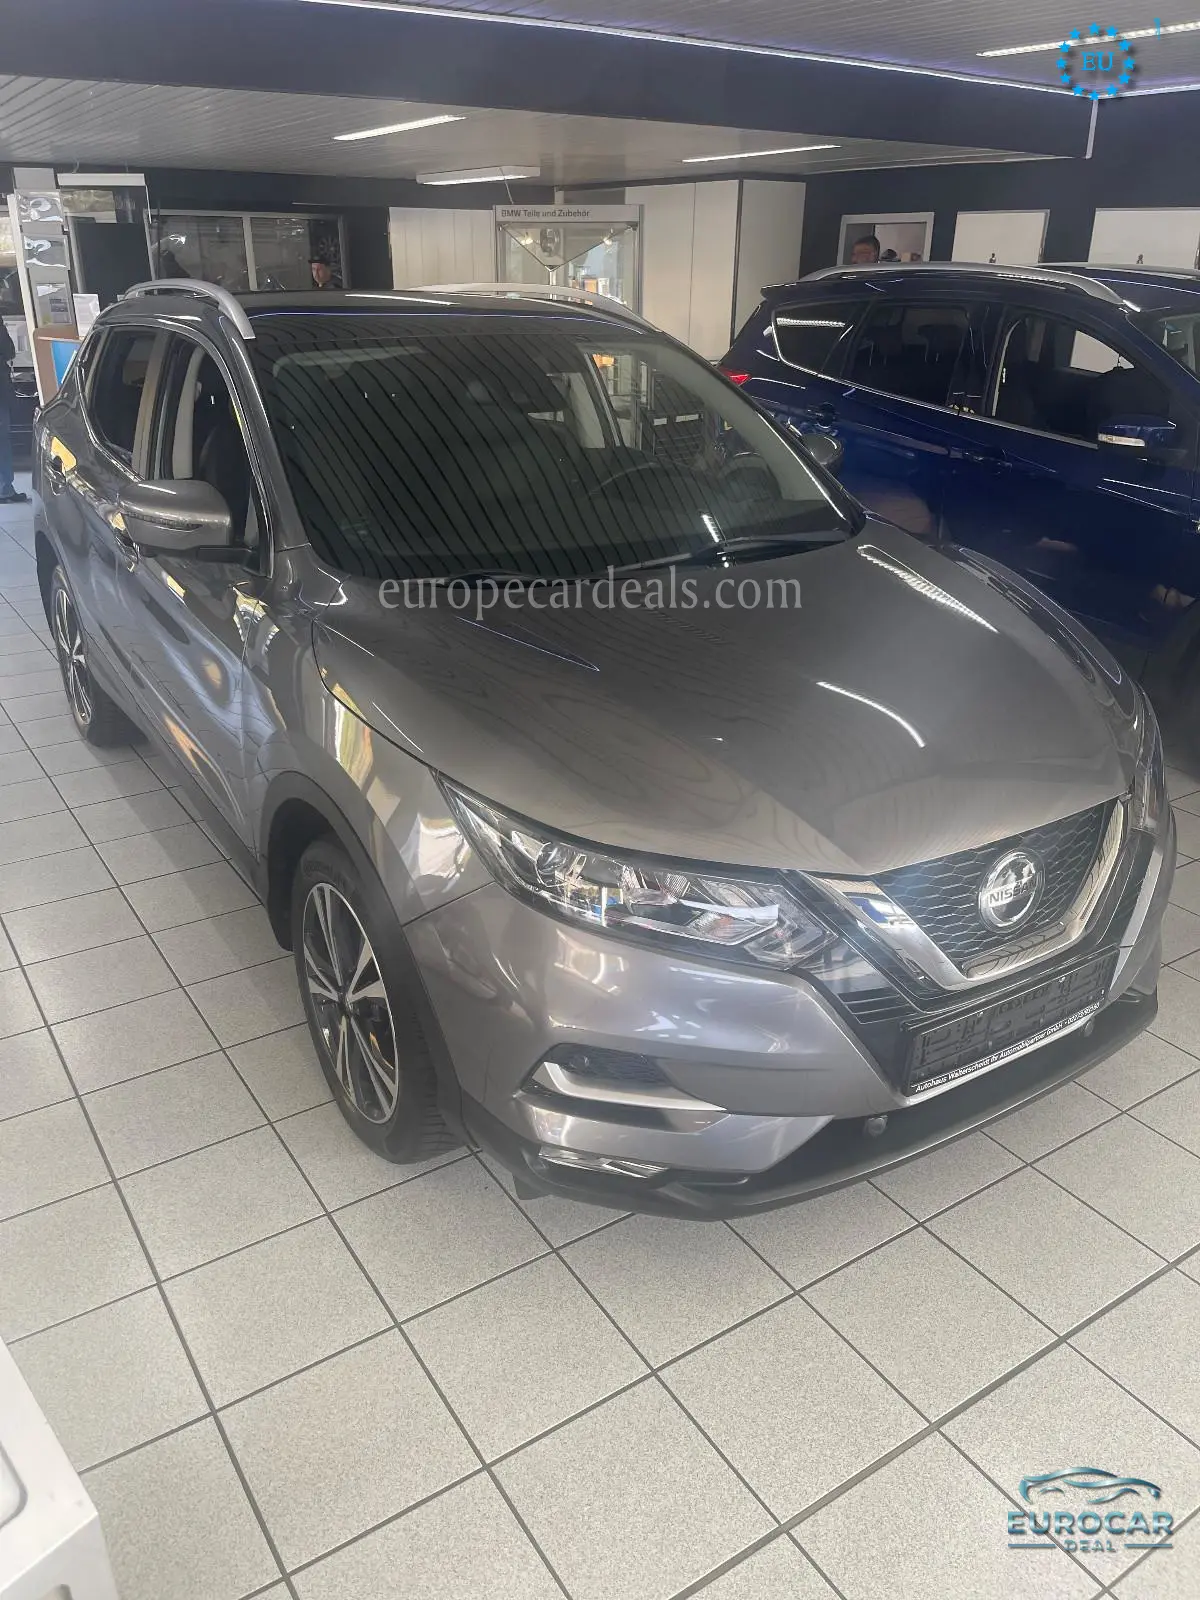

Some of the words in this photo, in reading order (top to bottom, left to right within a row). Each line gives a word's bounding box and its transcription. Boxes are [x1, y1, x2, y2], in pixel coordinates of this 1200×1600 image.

[501, 209, 521, 218] BMW
[523, 209, 540, 218] Teile
[542, 209, 556, 218] und
[557, 208, 590, 218] Zubehör
[915, 1075, 947, 1092] Autohaus
